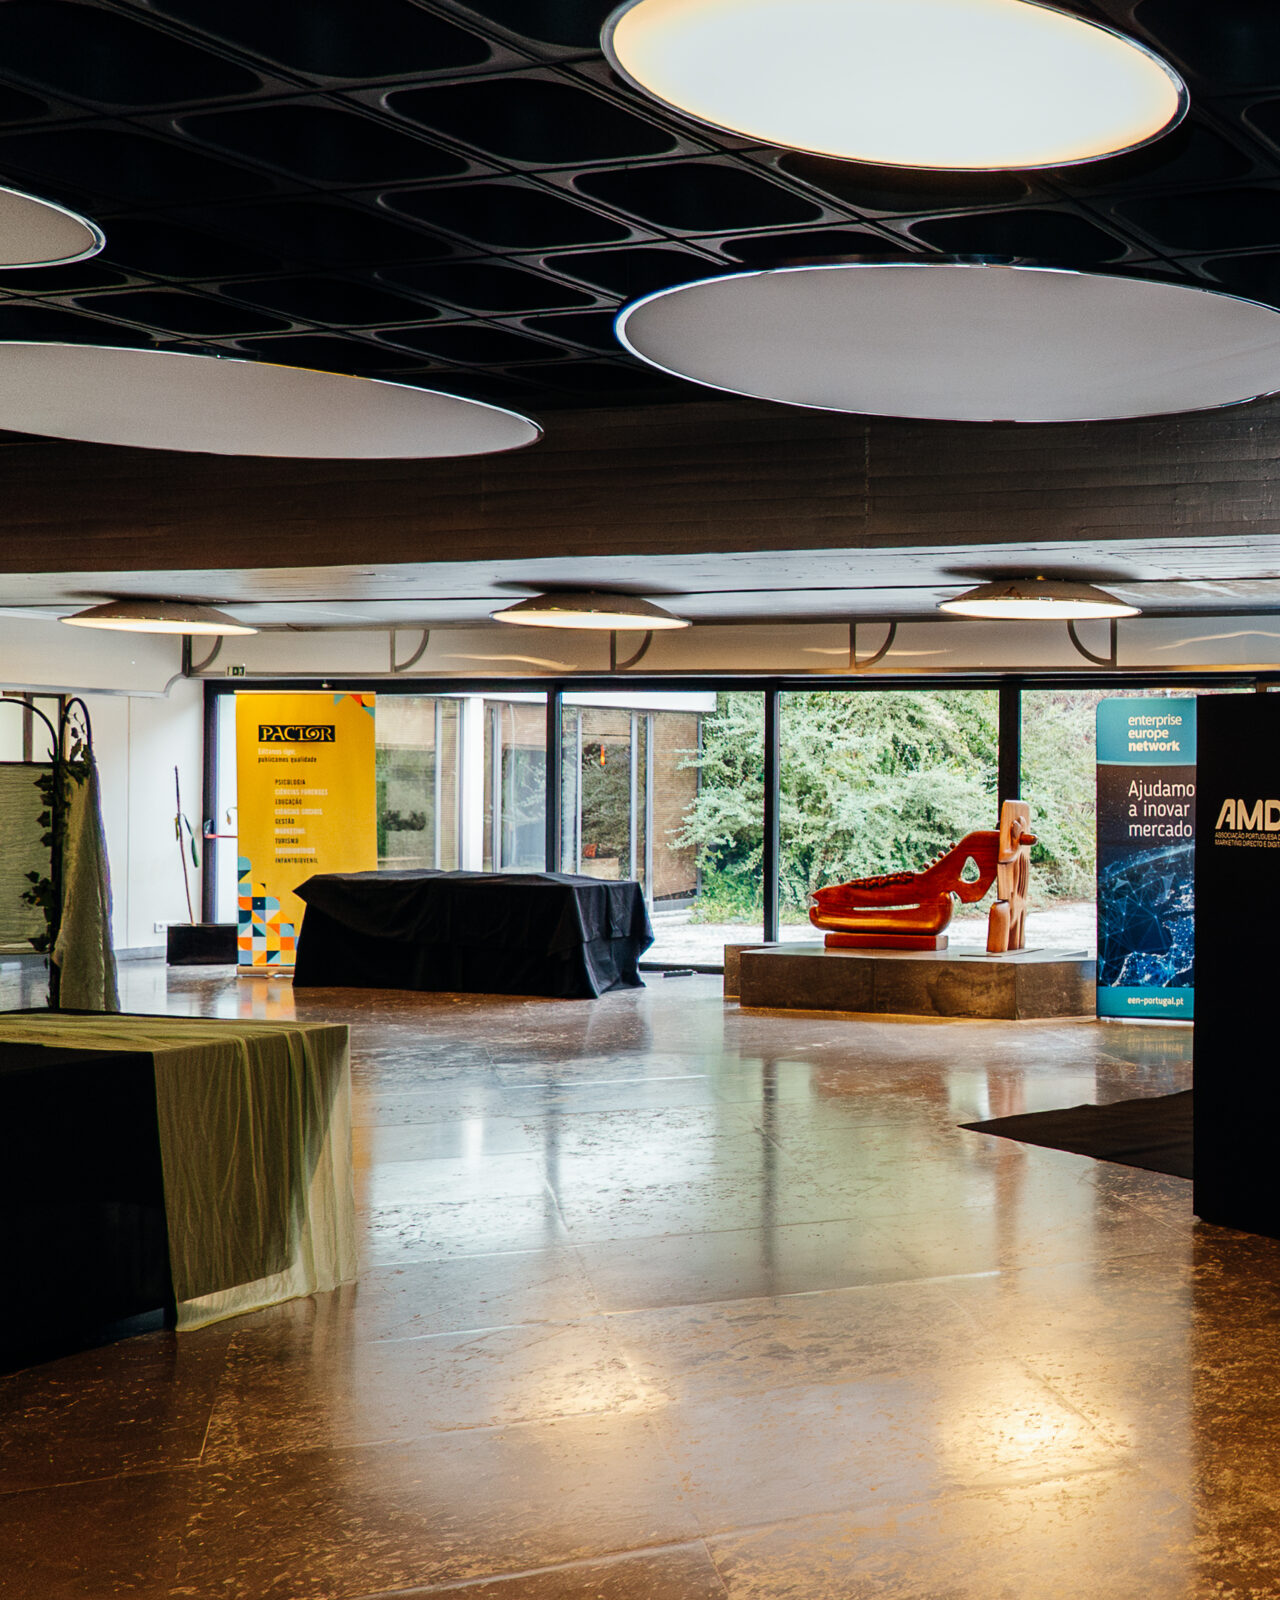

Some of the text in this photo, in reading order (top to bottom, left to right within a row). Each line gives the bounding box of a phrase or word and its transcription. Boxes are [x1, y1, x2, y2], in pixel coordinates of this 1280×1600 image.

[1128, 714, 1182, 728] enterprise
[260, 725, 334, 742] PACTOR
[1128, 730, 1169, 741] europe
[1128, 741, 1180, 752] network
[1128, 800, 1190, 817] a inovar
[1128, 820, 1193, 837] mercado
[1127, 996, 1184, 1007] een-portugal.pt
